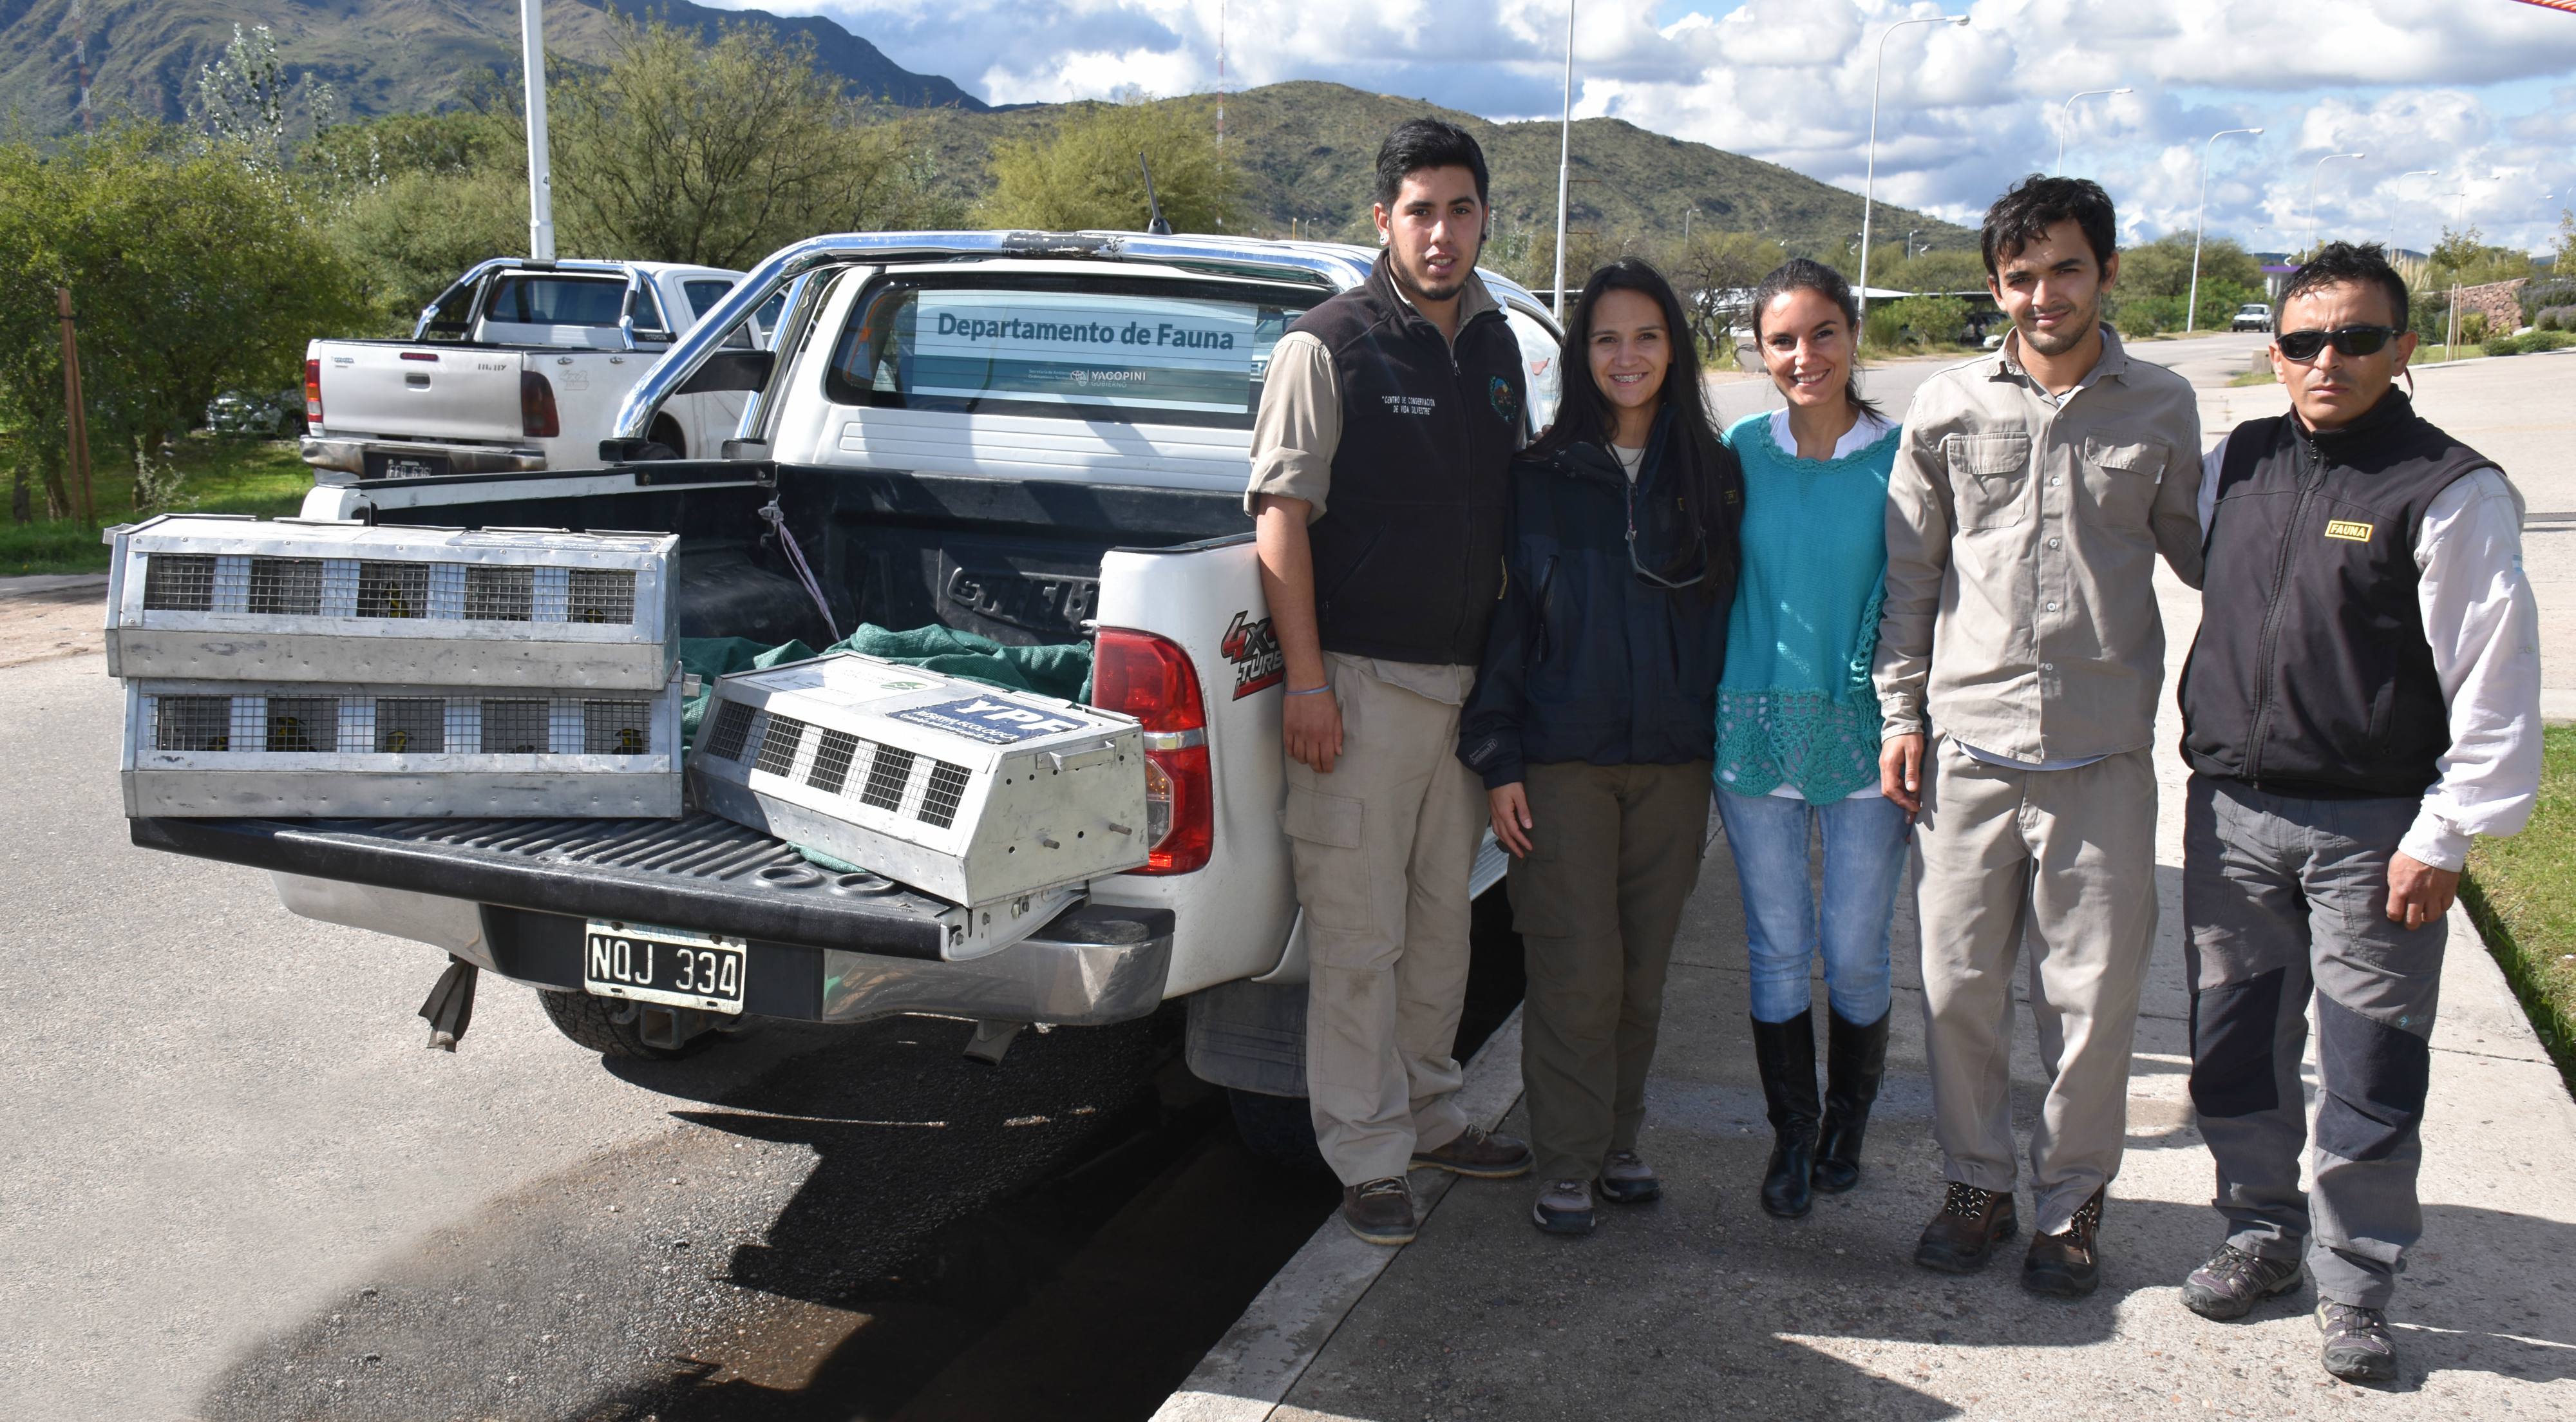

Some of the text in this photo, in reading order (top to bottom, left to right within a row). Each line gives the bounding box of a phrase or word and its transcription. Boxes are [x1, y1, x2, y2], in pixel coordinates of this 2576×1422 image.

[938, 312, 1234, 350] Departamento de Fauna
[2330, 524, 2366, 537] FAUNA
[954, 699, 1080, 732] YPF
[592, 937, 737, 996] NQJ 334
